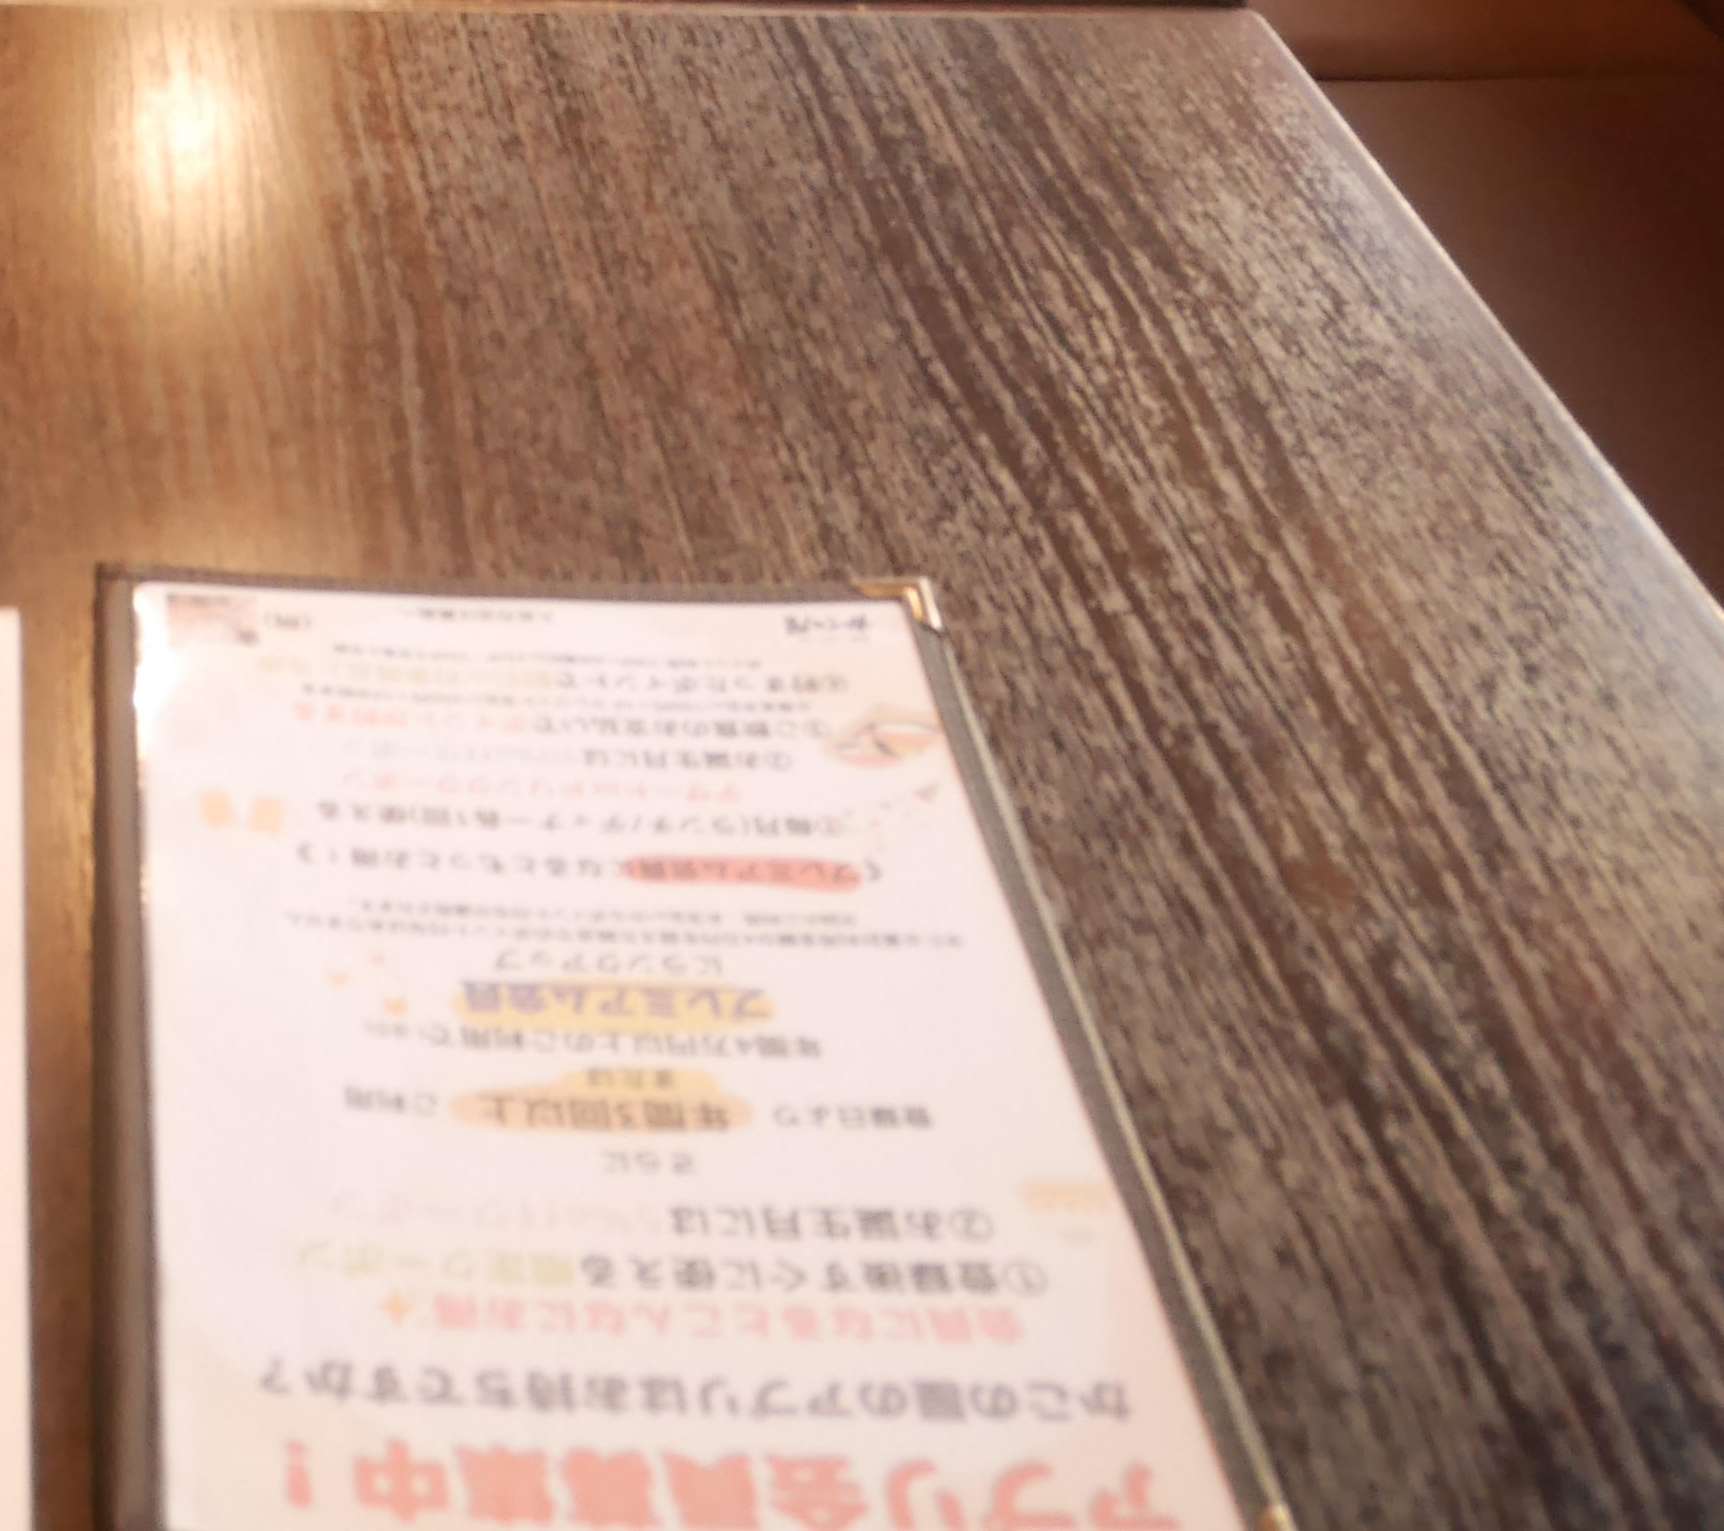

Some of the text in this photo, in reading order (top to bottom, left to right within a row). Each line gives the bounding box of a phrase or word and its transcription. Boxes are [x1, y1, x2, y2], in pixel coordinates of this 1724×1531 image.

[491, 949, 724, 978] にランクアップ
[460, 981, 768, 1023] プレミアム会員
[343, 1085, 439, 1117] ご利用
[600, 1150, 698, 1177] さらに
[257, 1357, 1131, 1424] かごの屋のアプリはお持ちですか？
[279, 1440, 1181, 1531] アプリ会員募集中！
